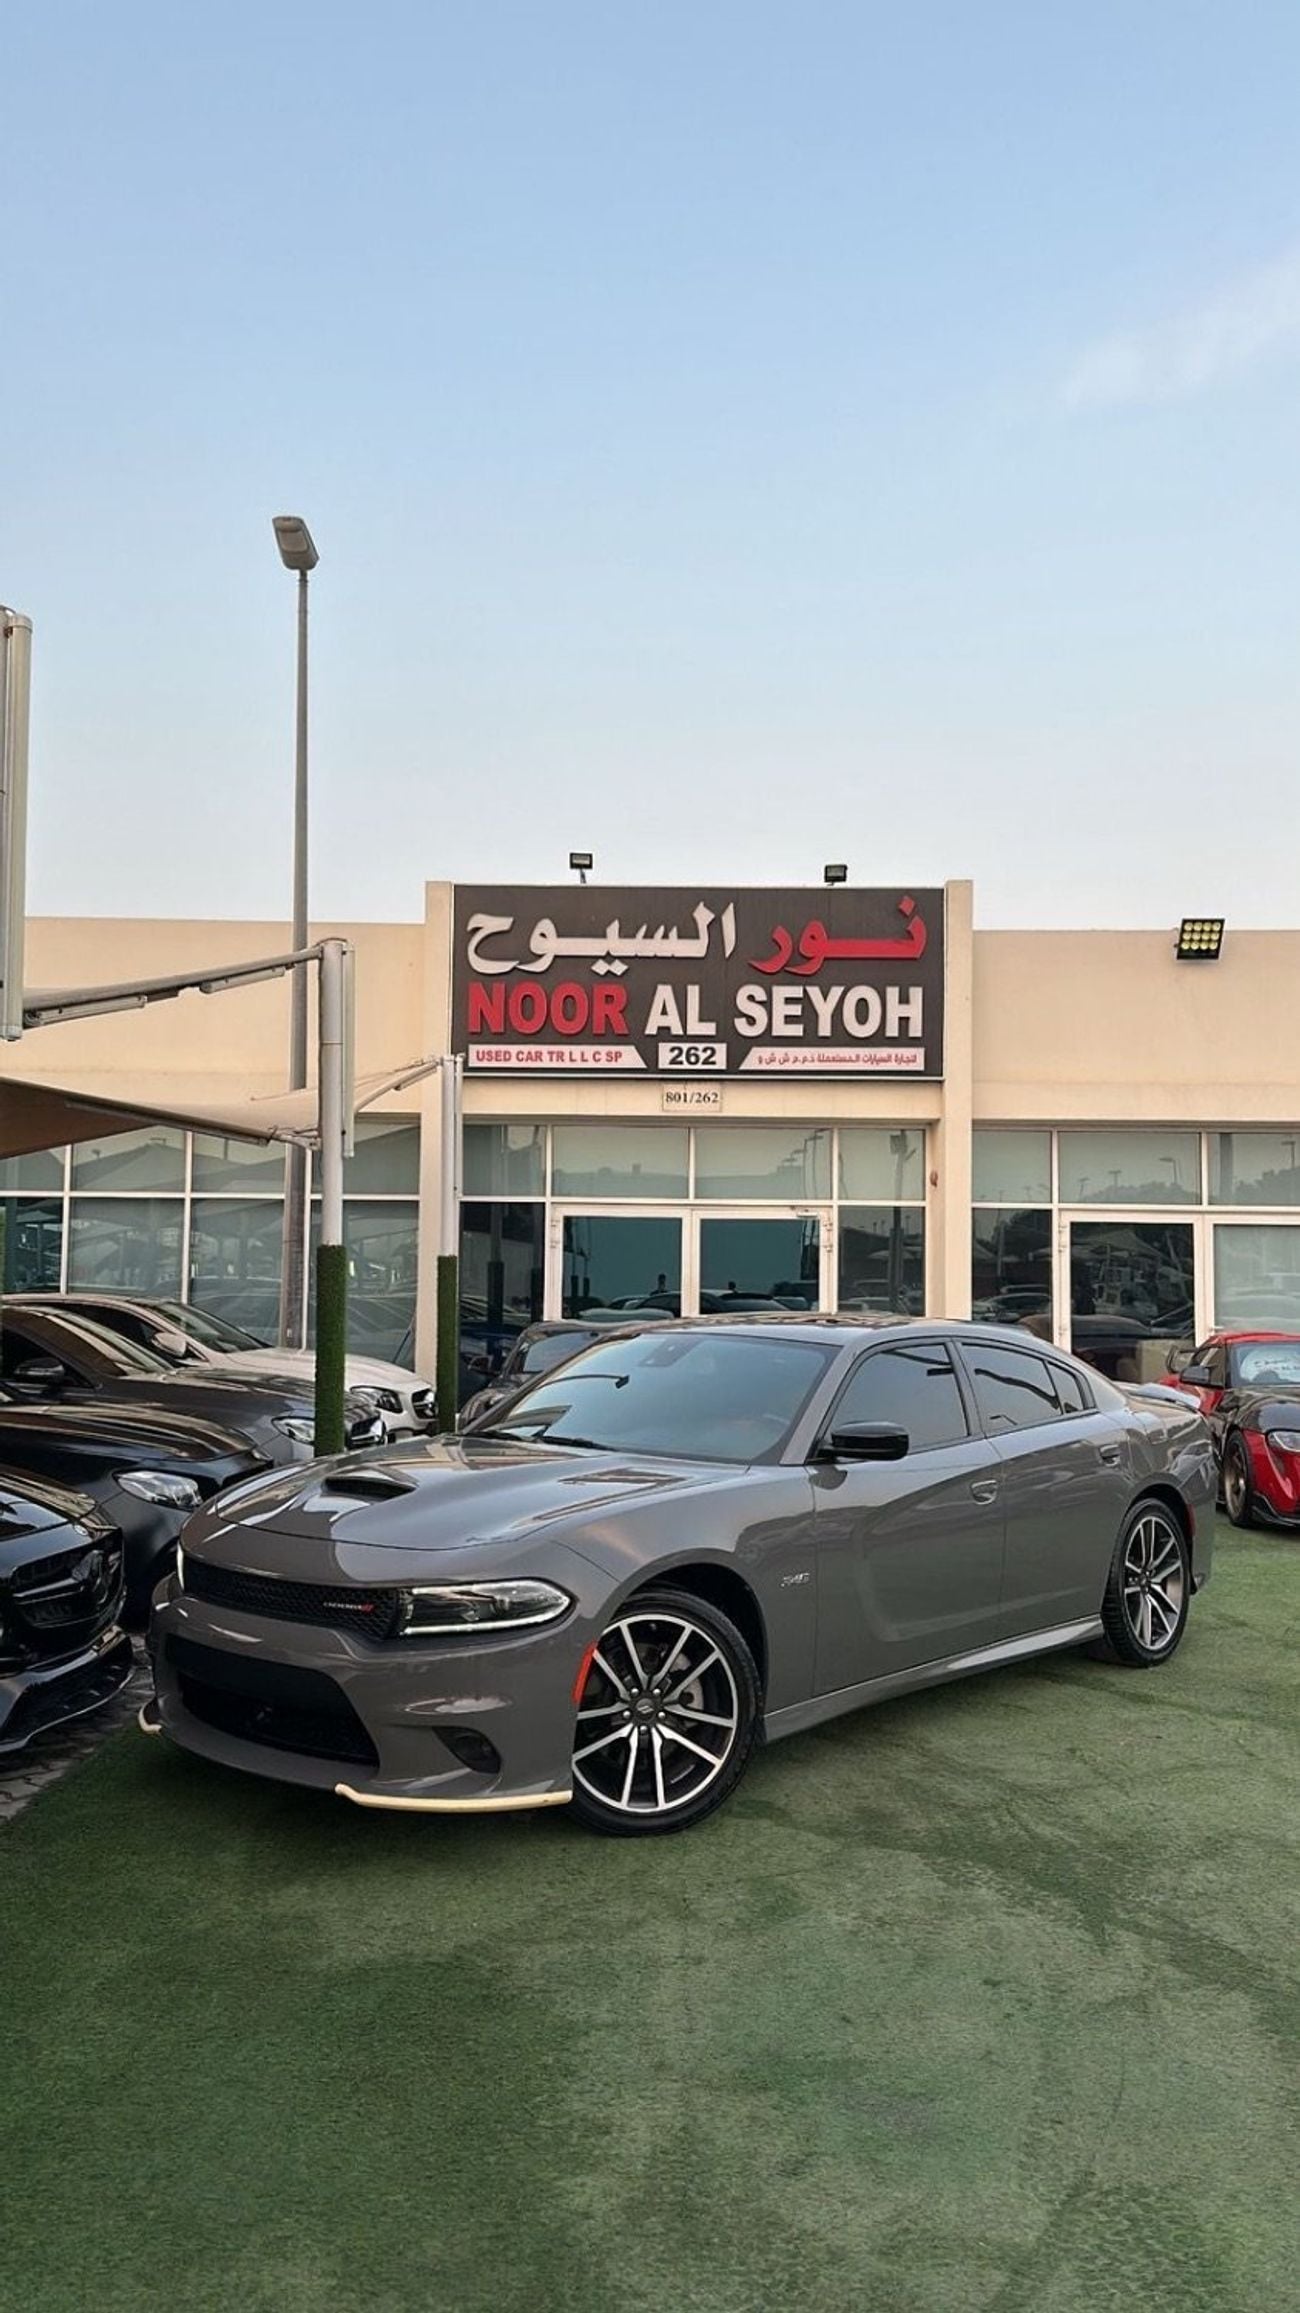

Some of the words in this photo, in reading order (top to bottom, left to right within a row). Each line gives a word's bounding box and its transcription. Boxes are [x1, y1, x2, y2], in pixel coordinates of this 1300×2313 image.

[466, 901, 736, 976] السيوح
[748, 895, 928, 976] نور
[467, 981, 629, 1036] NOOR
[645, 984, 716, 1036] AL
[734, 984, 924, 1038] SEYOH
[476, 1050, 512, 1063] USED
[516, 1050, 543, 1063] CAR
[546, 1051, 565, 1063] TR
[569, 1051, 577, 1063] L
[580, 1051, 588, 1063] L
[592, 1051, 601, 1063] C
[605, 1051, 623, 1063] SP
[668, 1046, 717, 1066] 262
[665, 1091, 719, 1105] 801/262
